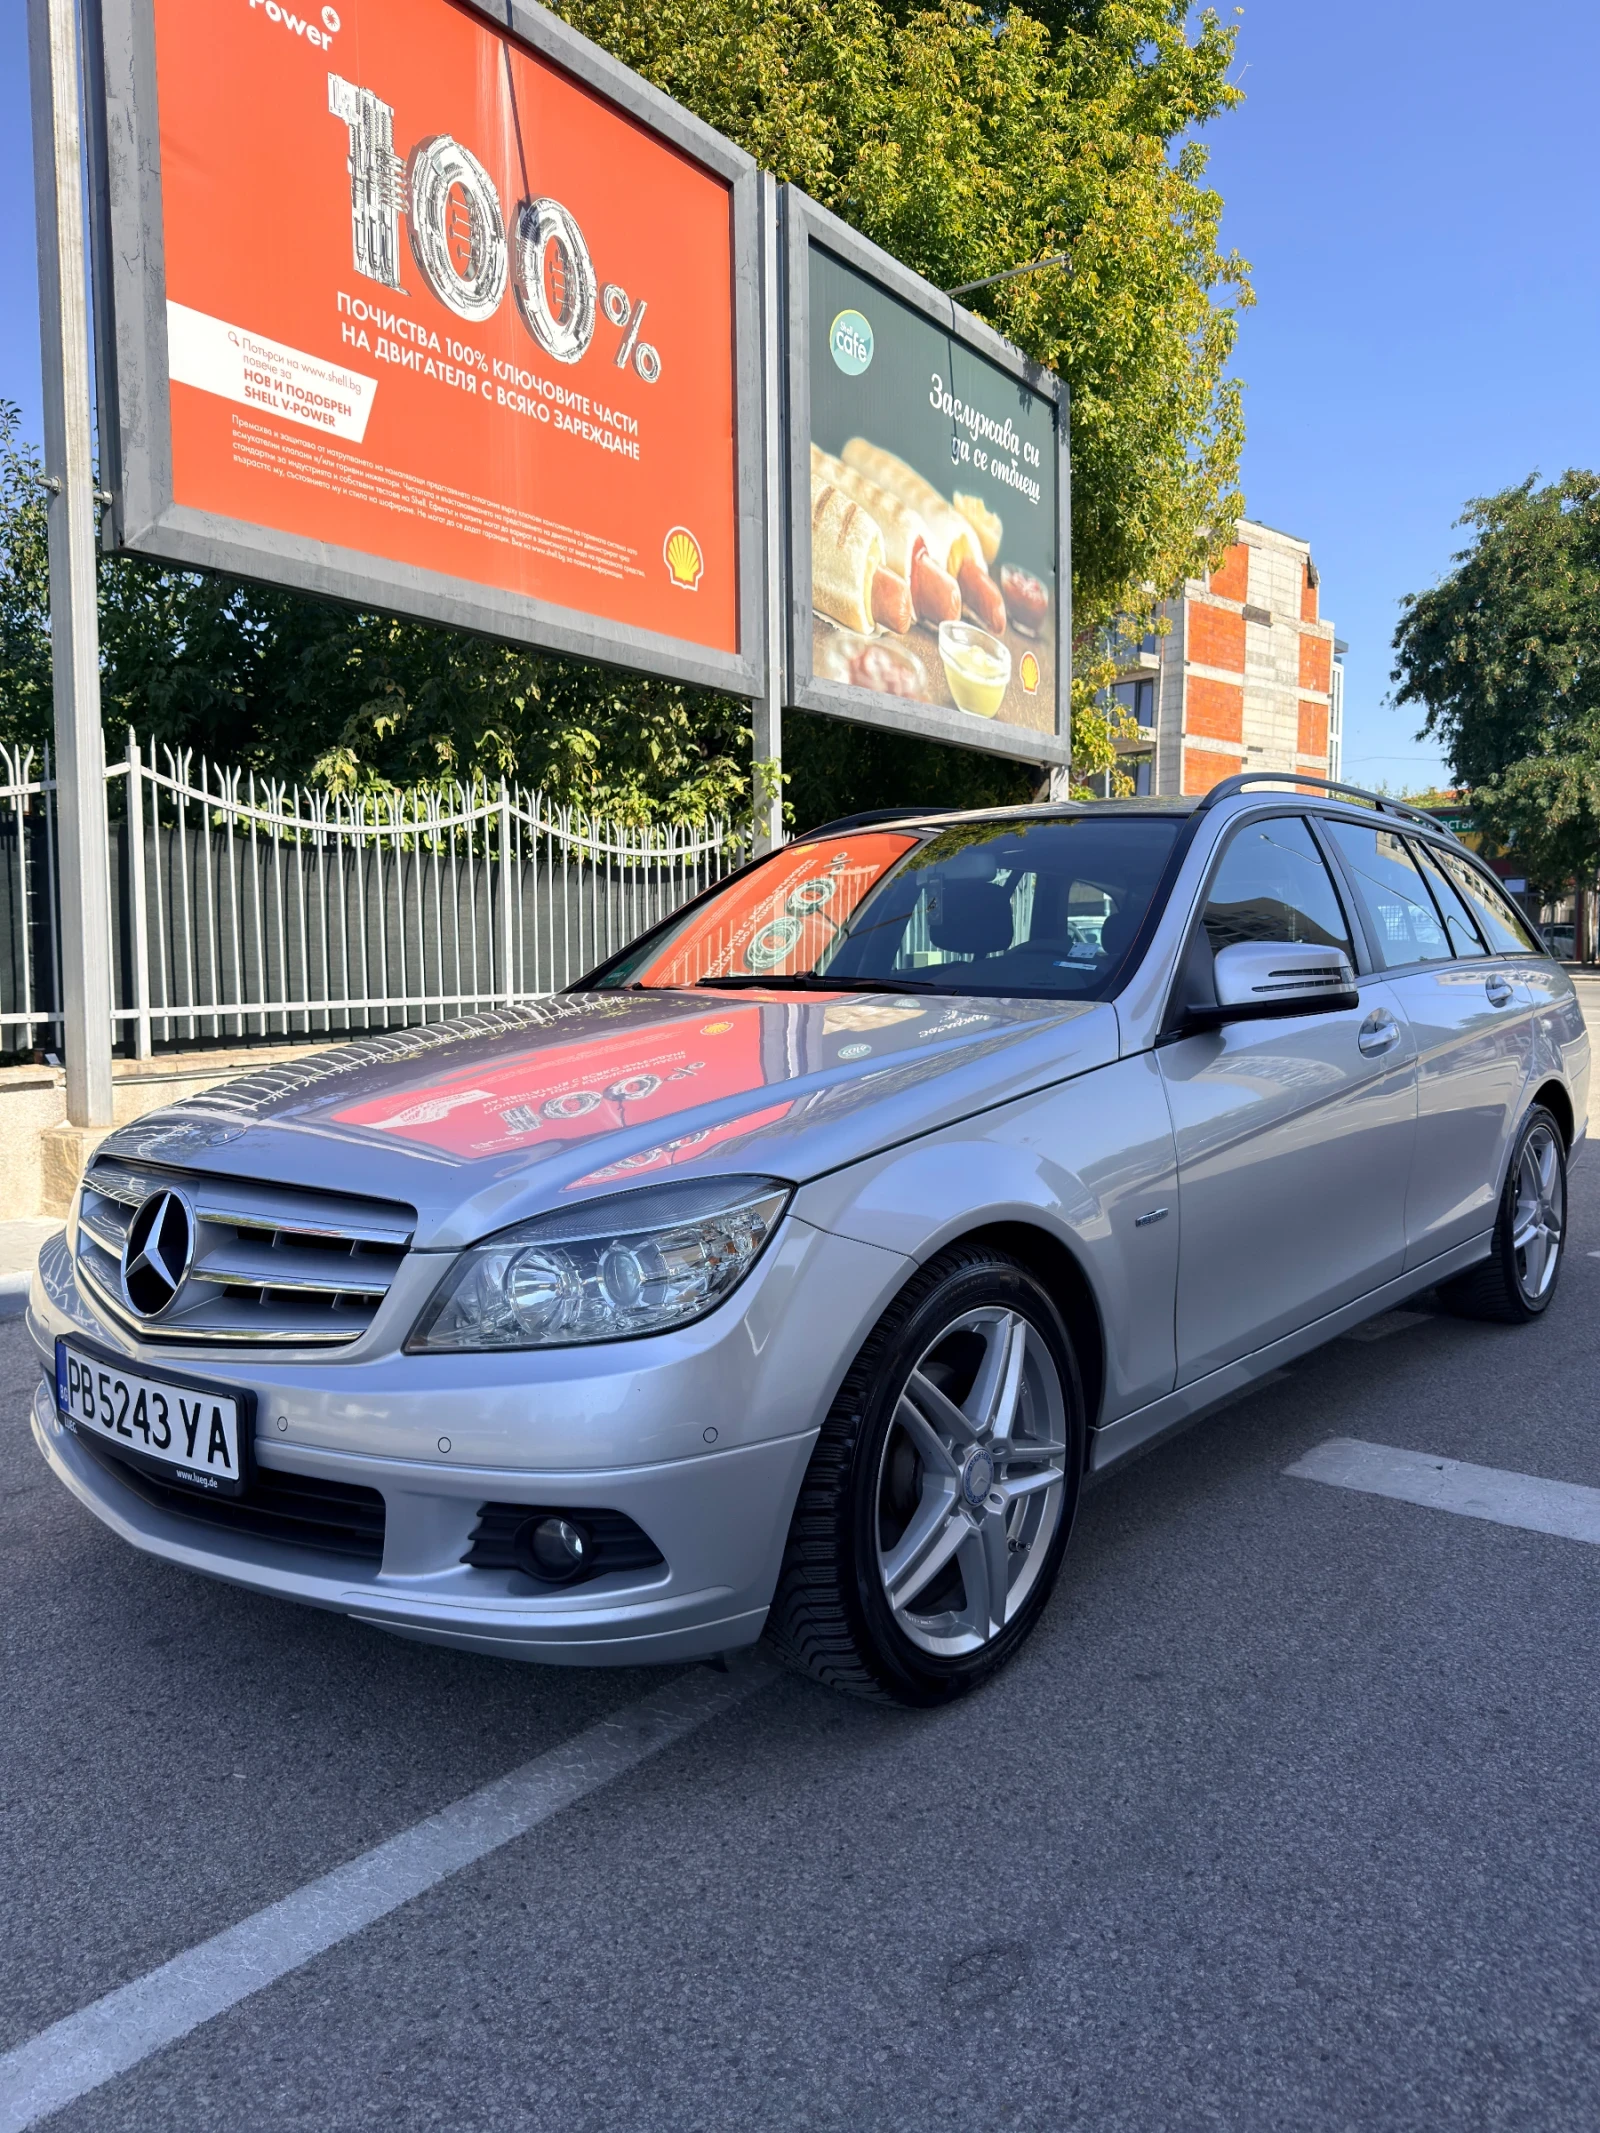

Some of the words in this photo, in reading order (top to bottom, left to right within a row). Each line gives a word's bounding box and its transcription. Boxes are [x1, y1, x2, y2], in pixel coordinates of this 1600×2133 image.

[327, 71, 662, 384] 100%
[242, 337, 285, 363] Потърси
[286, 358, 299, 370] на
[301, 363, 362, 396] www.shell.bg
[243, 355, 278, 374] повече
[280, 369, 292, 380] за
[337, 291, 442, 354] ПОЧИСТВА
[446, 337, 489, 372] 100%
[493, 358, 590, 416] КЛЮЧОВИТЕ
[593, 401, 638, 437] ЧАСТИ
[835, 332, 867, 363] café
[244, 368, 271, 388] НОВ
[274, 379, 283, 392] И
[286, 383, 352, 417] ПОДОБРЕН
[244, 385, 279, 408] SHELL
[281, 398, 336, 427] V-POWER
[342, 322, 371, 353] НА
[375, 336, 477, 395] ДВИГАТЕЛЯ
[481, 381, 492, 401] С
[497, 386, 550, 423] ВСЯКО
[554, 409, 640, 461] ЗАРЕЖДАНЕ
[231, 413, 272, 435] Премахва
[929, 373, 1020, 456] Заслужава
[1023, 440, 1040, 468] си
[232, 441, 275, 460] стандартни
[232, 454, 271, 471] възрастта
[974, 448, 988, 471] се
[991, 458, 1041, 505] отбиеш
[60, 1384, 68, 1402] BG
[176, 1469, 218, 1488] www.lueg.de
